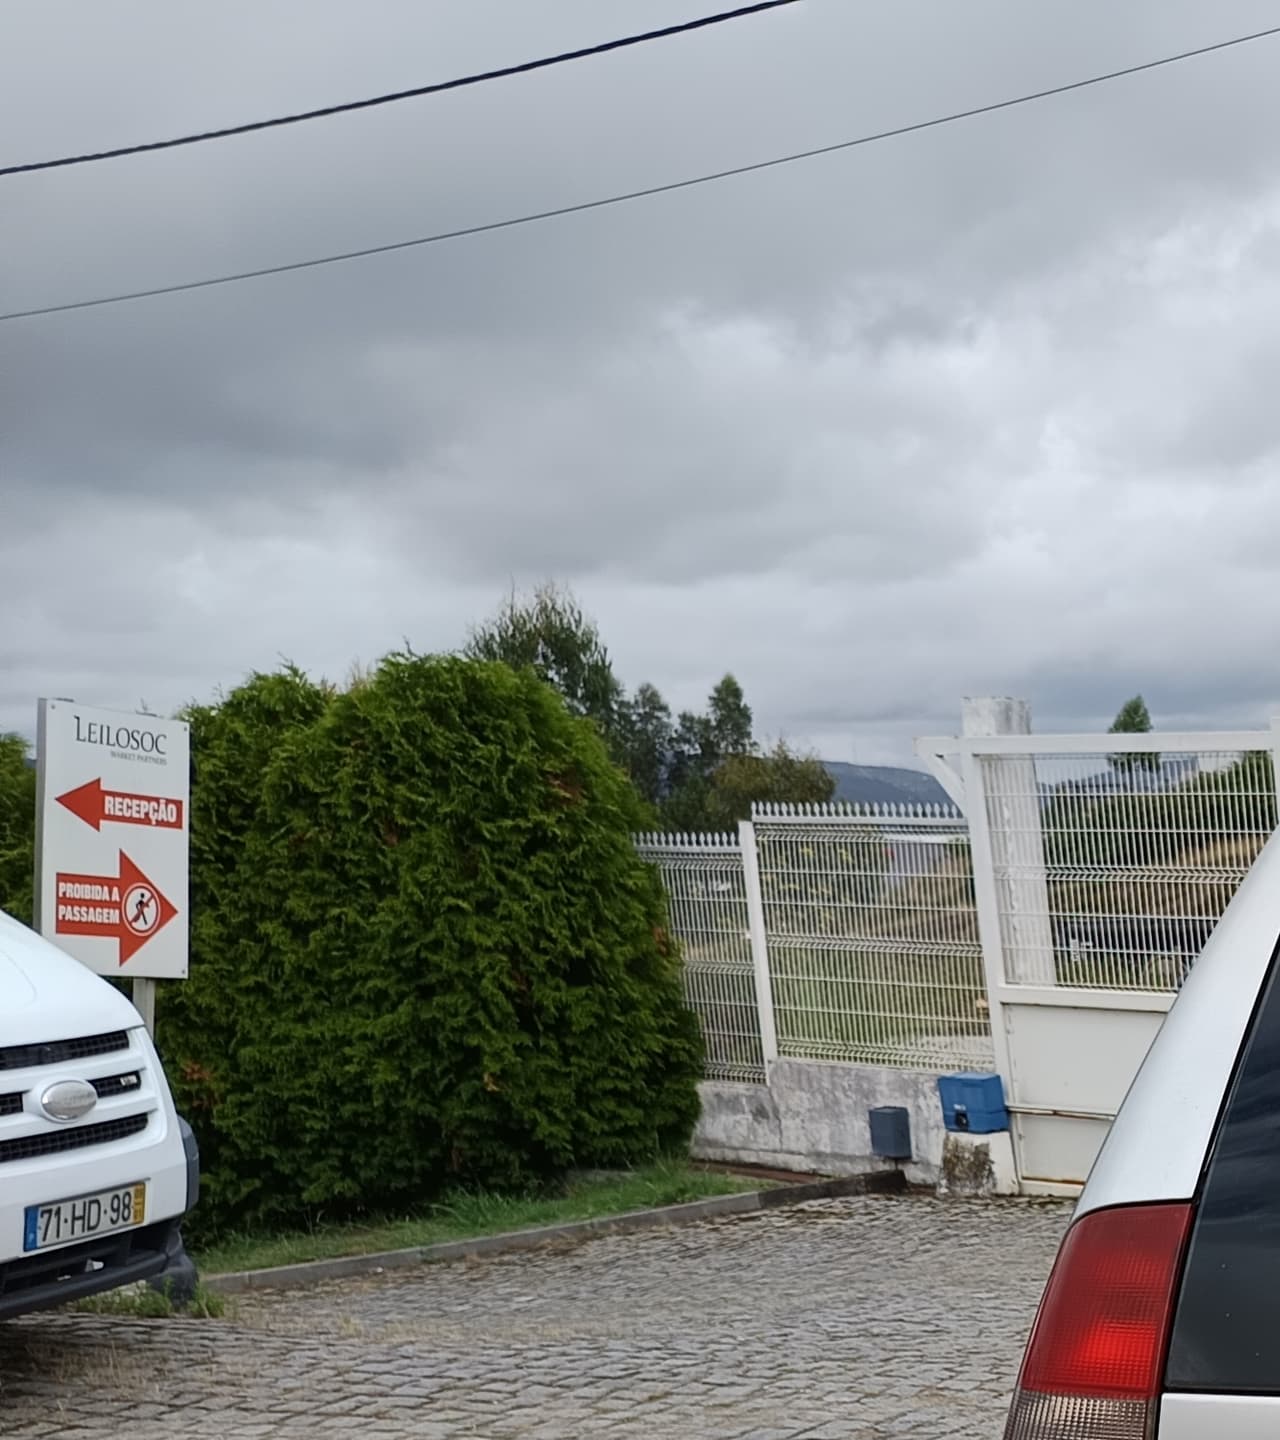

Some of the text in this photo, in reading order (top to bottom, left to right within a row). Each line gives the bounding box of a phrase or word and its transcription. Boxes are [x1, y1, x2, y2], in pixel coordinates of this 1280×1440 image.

[74, 715, 167, 755] LEILOSOC
[104, 795, 177, 825] RECEPÇÃO
[58, 882, 121, 902] PROIBIDA A
[58, 905, 120, 924] PASSAGEM
